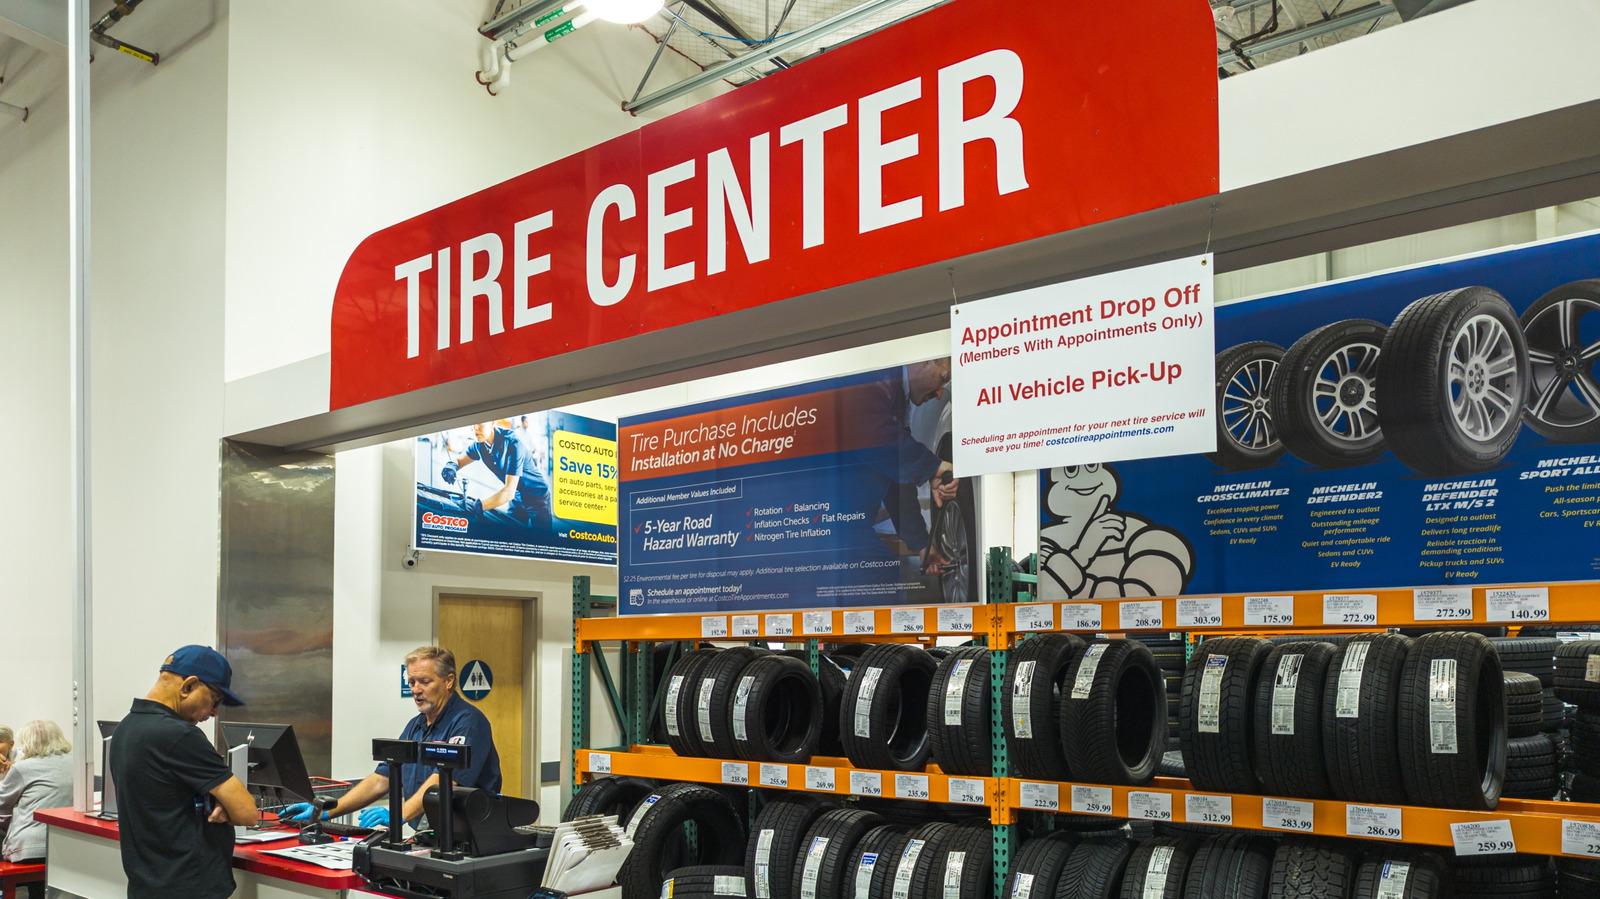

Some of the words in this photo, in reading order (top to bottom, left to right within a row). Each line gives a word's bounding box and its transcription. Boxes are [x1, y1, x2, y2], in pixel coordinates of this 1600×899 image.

[395, 210, 553, 359] TIRE
[586, 48, 1030, 307] CENTER
[962, 306, 1092, 345] Appointment
[1101, 298, 1155, 318] Drop
[1164, 284, 1200, 307] Off
[960, 346, 1020, 366] (Members
[1025, 338, 1053, 352] With
[1058, 323, 1156, 347] Appointments
[1162, 312, 1202, 329] Only)
[977, 386, 1001, 406] All
[1009, 376, 1084, 400] Vehicle
[1093, 362, 1182, 388] Pick-Up
[631, 434, 659, 452] Tire
[664, 423, 736, 447] Purchase
[741, 407, 817, 434] Includes
[962, 435, 1004, 445] Scheduling
[1019, 426, 1071, 439] appointment
[1088, 422, 1108, 432] your
[1111, 418, 1130, 427] next
[1151, 413, 1185, 422] service
[1189, 409, 1205, 418] will
[986, 442, 1004, 453] save
[1006, 444, 1021, 452] you
[1023, 440, 1044, 448] time!
[1046, 426, 1174, 445] costcotireappointments.com
[559, 440, 591, 452] COSTCO
[593, 447, 613, 457] AUTO
[632, 451, 700, 470] Installation
[702, 446, 715, 460] at
[719, 442, 738, 458] No
[1537, 456, 1600, 468] MICHEL
[560, 457, 592, 475] Save
[1519, 468, 1572, 480] SPORT
[1214, 481, 1271, 492] MICHELIN
[1312, 482, 1377, 494] MICHELIN
[1424, 479, 1496, 492] MICHELIN
[636, 495, 665, 504] Additional
[666, 492, 690, 501] Member
[691, 488, 709, 498] Values
[710, 485, 736, 495] Included
[1197, 488, 1290, 502] CROSSCLIMATE2
[1307, 492, 1383, 504] DEFENDER2
[1422, 489, 1499, 501] DEFENDER
[794, 503, 829, 512] Balancing
[1454, 500, 1484, 509] M/S
[754, 507, 782, 515] Rotation
[837, 512, 865, 521] Repairs
[1311, 509, 1346, 517] Engineered
[423, 513, 467, 527] COSTCO
[645, 520, 681, 534] 5-Year
[683, 514, 712, 530] Road
[755, 520, 782, 528] Inflation
[783, 517, 809, 526] Checks
[1312, 520, 1351, 528] Outstanding
[569, 530, 617, 543] CostcoAuto.
[755, 533, 784, 541] Nitrogen
[801, 529, 830, 537] Inflation
[644, 535, 684, 550] Hazard
[756, 566, 783, 574] Additional
[795, 564, 821, 572] selection
[822, 563, 848, 571] available
[860, 560, 900, 568] Costco.com
[648, 588, 674, 596] Schedule
[683, 586, 721, 596] appointment
[722, 584, 742, 594] today!
[1263, 615, 1292, 623] 175.99
[1343, 614, 1375, 623] 272.99
[1436, 609, 1471, 617] 272.99
[1511, 609, 1547, 619] 140.99
[1030, 620, 1052, 628] 154.99
[1077, 620, 1100, 628] 186.99
[1135, 618, 1161, 626] 208.99
[1194, 616, 1221, 624] 303.99
[904, 624, 923, 632] 286.99
[1035, 800, 1057, 808] 222.99
[1087, 804, 1111, 812] 259.99
[1144, 810, 1170, 819] 252.99
[1203, 814, 1230, 822] 312.99
[1281, 819, 1311, 829] 283.99
[1367, 826, 1400, 837] 286.99
[1478, 840, 1513, 851] 259.99
